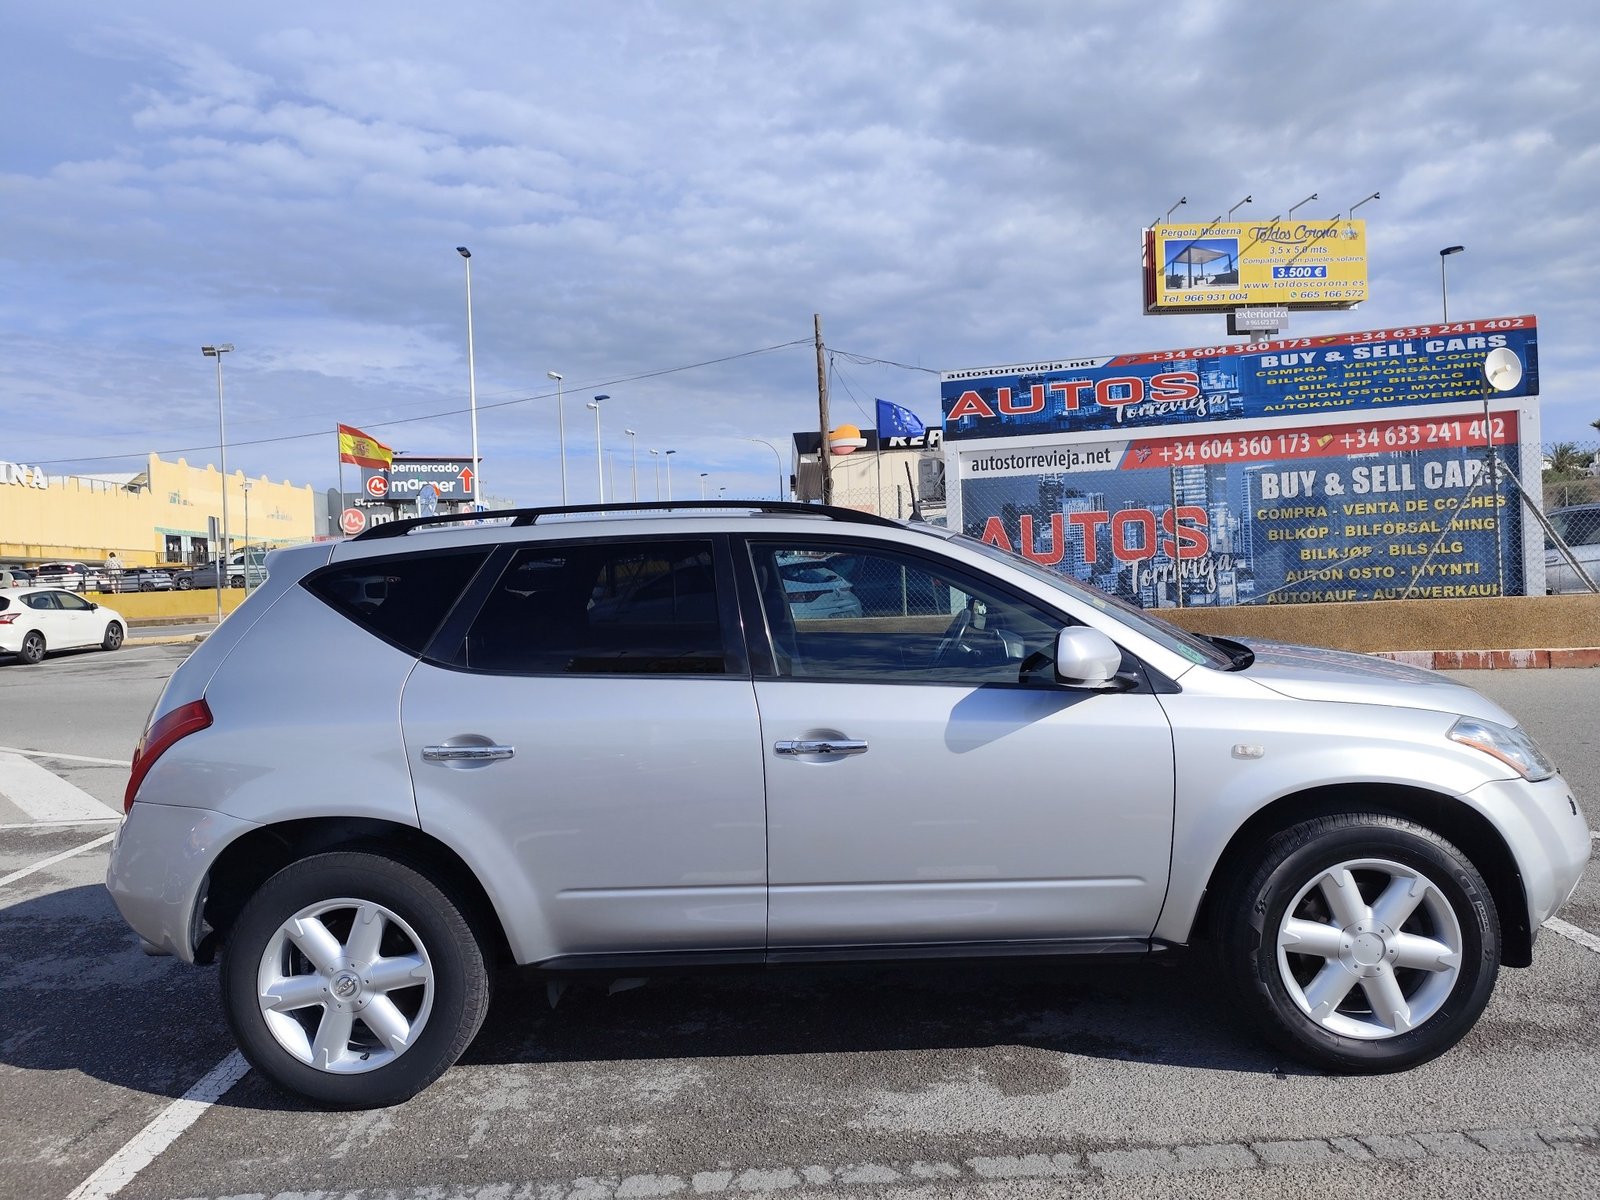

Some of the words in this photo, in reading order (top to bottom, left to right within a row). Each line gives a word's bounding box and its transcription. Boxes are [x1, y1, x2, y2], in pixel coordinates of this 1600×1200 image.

[1201, 227, 1241, 236] Moderna
[1248, 224, 1291, 243] Toldos
[1294, 224, 1338, 241] Corona
[1277, 267, 1311, 277] 3.500
[1314, 267, 1324, 277] €
[1163, 295, 1181, 303] Tel.
[1184, 294, 1204, 302] 966
[1206, 293, 1225, 301] 931
[1228, 292, 1248, 300] 004
[1300, 291, 1320, 299] 665
[1324, 290, 1342, 298] 166
[1345, 289, 1364, 297] 572
[1235, 309, 1288, 319] exterioriza
[1345, 330, 1387, 342] +34
[1393, 326, 1430, 338] 633
[1438, 321, 1476, 334] 241
[1484, 318, 1524, 329] 402
[1148, 351, 1187, 361] +34
[1192, 344, 1228, 357] 604
[1234, 342, 1270, 354] 360
[1276, 338, 1312, 349] 173
[1261, 351, 1317, 368] BUY
[1324, 351, 1345, 362] &
[1353, 342, 1417, 360] SELL
[1425, 334, 1508, 354] CARS
[947, 359, 1096, 379] autostorrevieja.net
[1256, 365, 1327, 377] COMPRA
[1343, 359, 1400, 369] VENTA
[1406, 356, 1429, 364] DE
[1435, 351, 1490, 361] COCH
[1266, 373, 1328, 385] BILKÖP
[1344, 361, 1484, 379] BILFÖRSÄLJNIN
[1284, 391, 1342, 401] AUTON
[1347, 386, 1394, 396] OSTO
[1411, 379, 1480, 391] MYYNTI
[1299, 379, 1372, 391] BILKJØP
[1388, 372, 1464, 384] BILSALG
[946, 371, 1200, 421] AUTOS
[1263, 398, 1355, 411] AUTOKAUF
[1110, 394, 1227, 423] Torrevieja
[1340, 427, 1379, 449] +34
[1384, 424, 1420, 446] 633
[1426, 421, 1461, 443] 241
[1468, 417, 1505, 440] 402
[1159, 442, 1196, 462] +34
[1200, 440, 1234, 460] 604
[1238, 435, 1272, 456] 360
[1277, 432, 1311, 454] 173
[971, 447, 1112, 472] autostorrevieja.net
[1261, 470, 1317, 500] BUY
[1324, 471, 1345, 496] &
[1353, 465, 1416, 494] SELL
[354, 498, 385, 508] sup
[1257, 505, 1328, 521] COMPRA
[1343, 502, 1400, 516] VENTA
[1405, 499, 1429, 512] DE
[981, 505, 1210, 566] AUTOS
[1268, 525, 1329, 541] BILKÖP
[1300, 545, 1373, 561] BILKJØP
[1125, 553, 1234, 594] Torrvieja
[1285, 568, 1344, 582] AUTON
[1349, 566, 1395, 580] OSTO
[1266, 589, 1357, 604] AUTOKAUF
